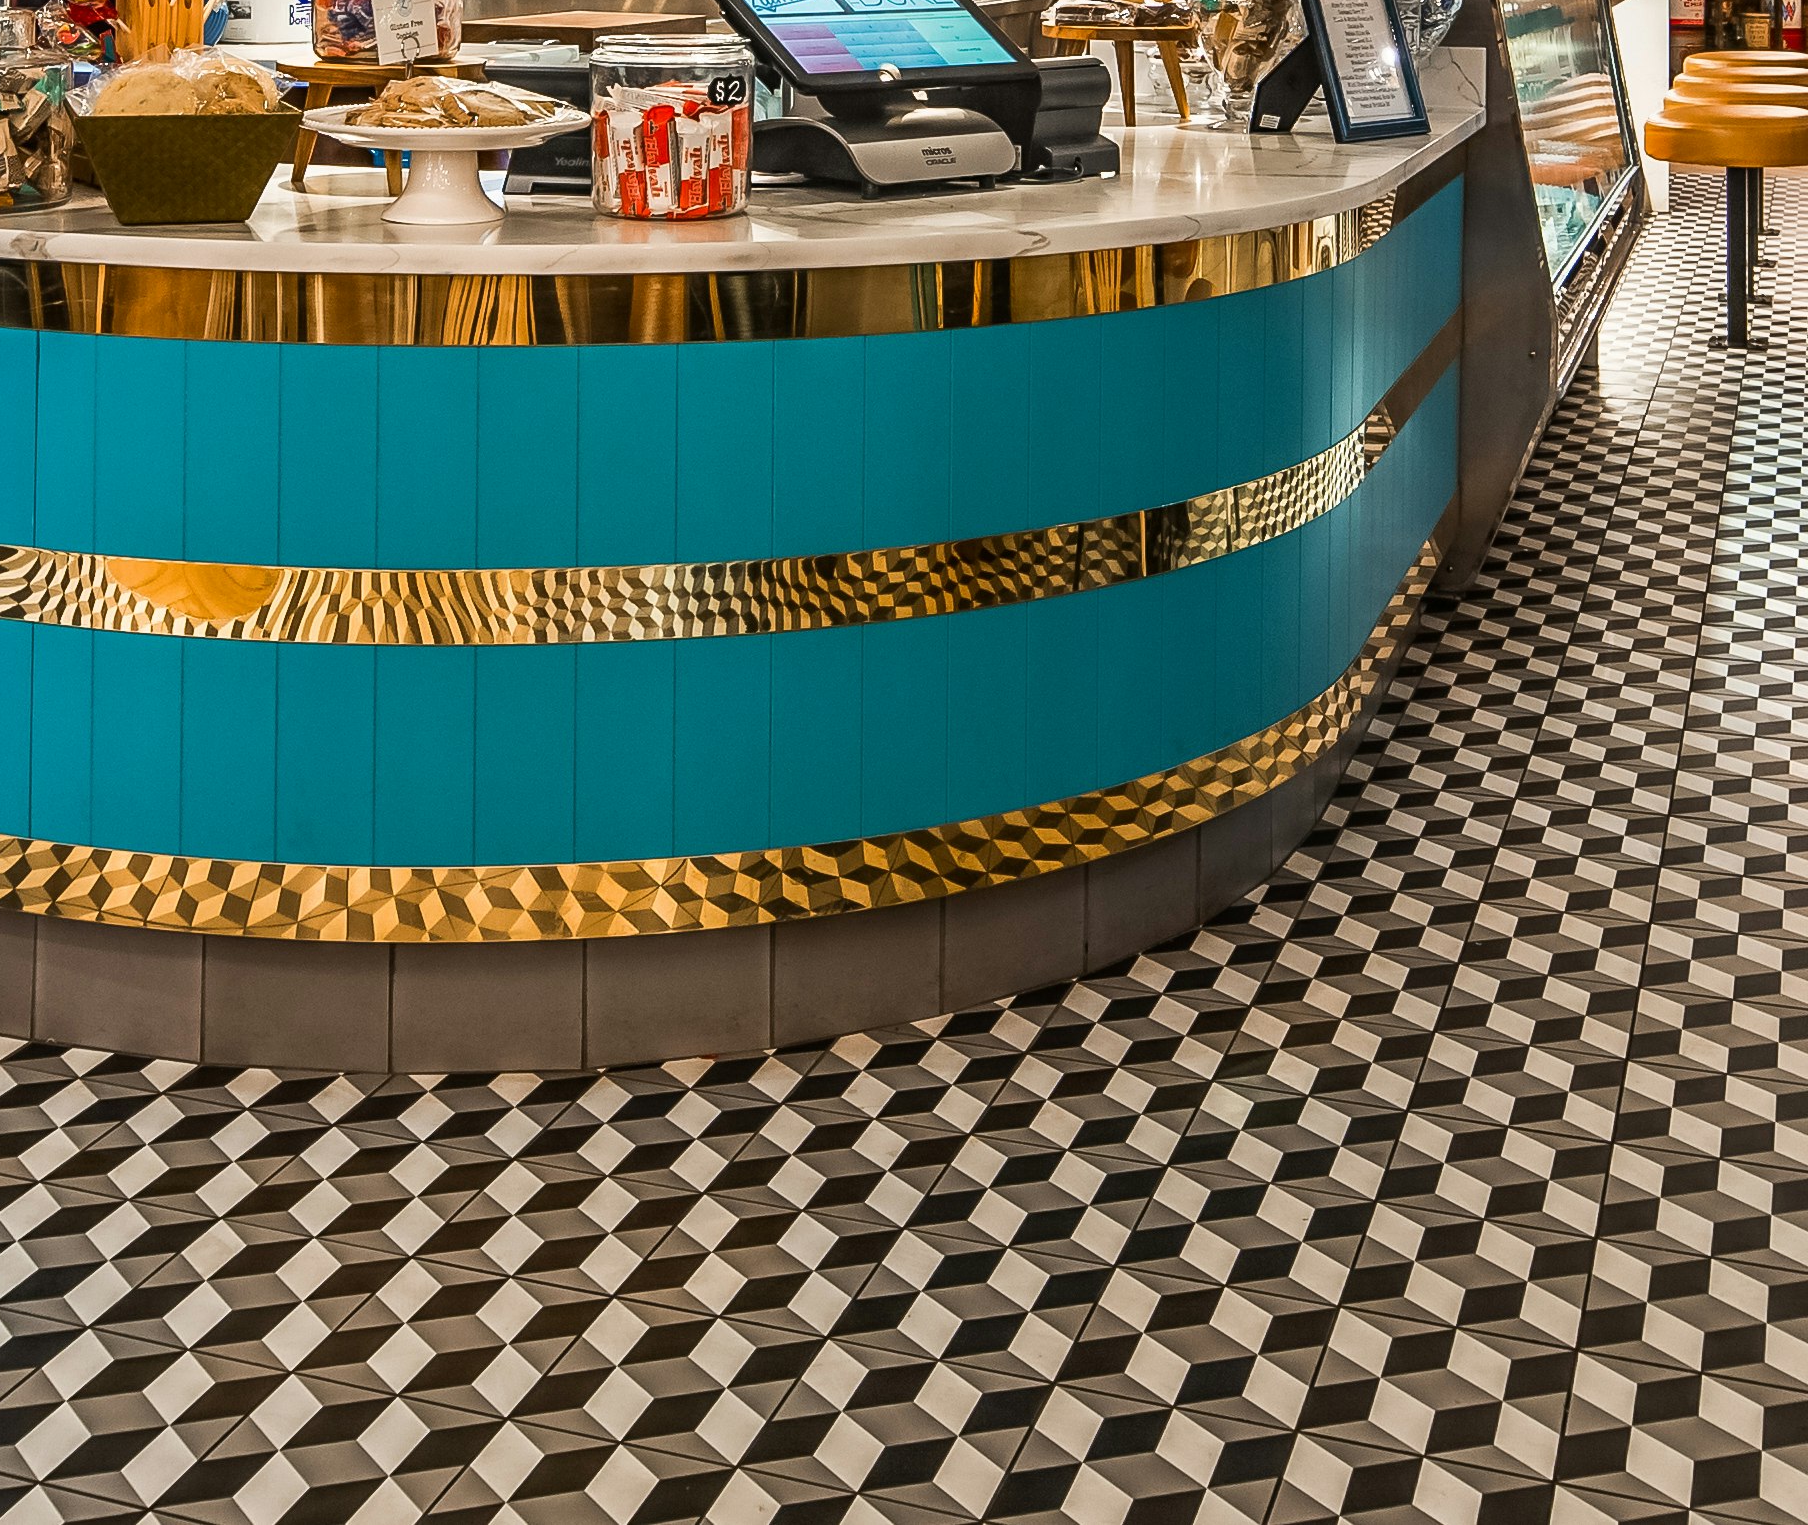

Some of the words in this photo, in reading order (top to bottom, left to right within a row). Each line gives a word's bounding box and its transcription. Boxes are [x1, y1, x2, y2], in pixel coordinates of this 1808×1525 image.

[715, 80, 743, 102] $2
[921, 146, 952, 157] micros
[925, 157, 957, 166] ORACLE
[688, 146, 703, 207] Halvah
